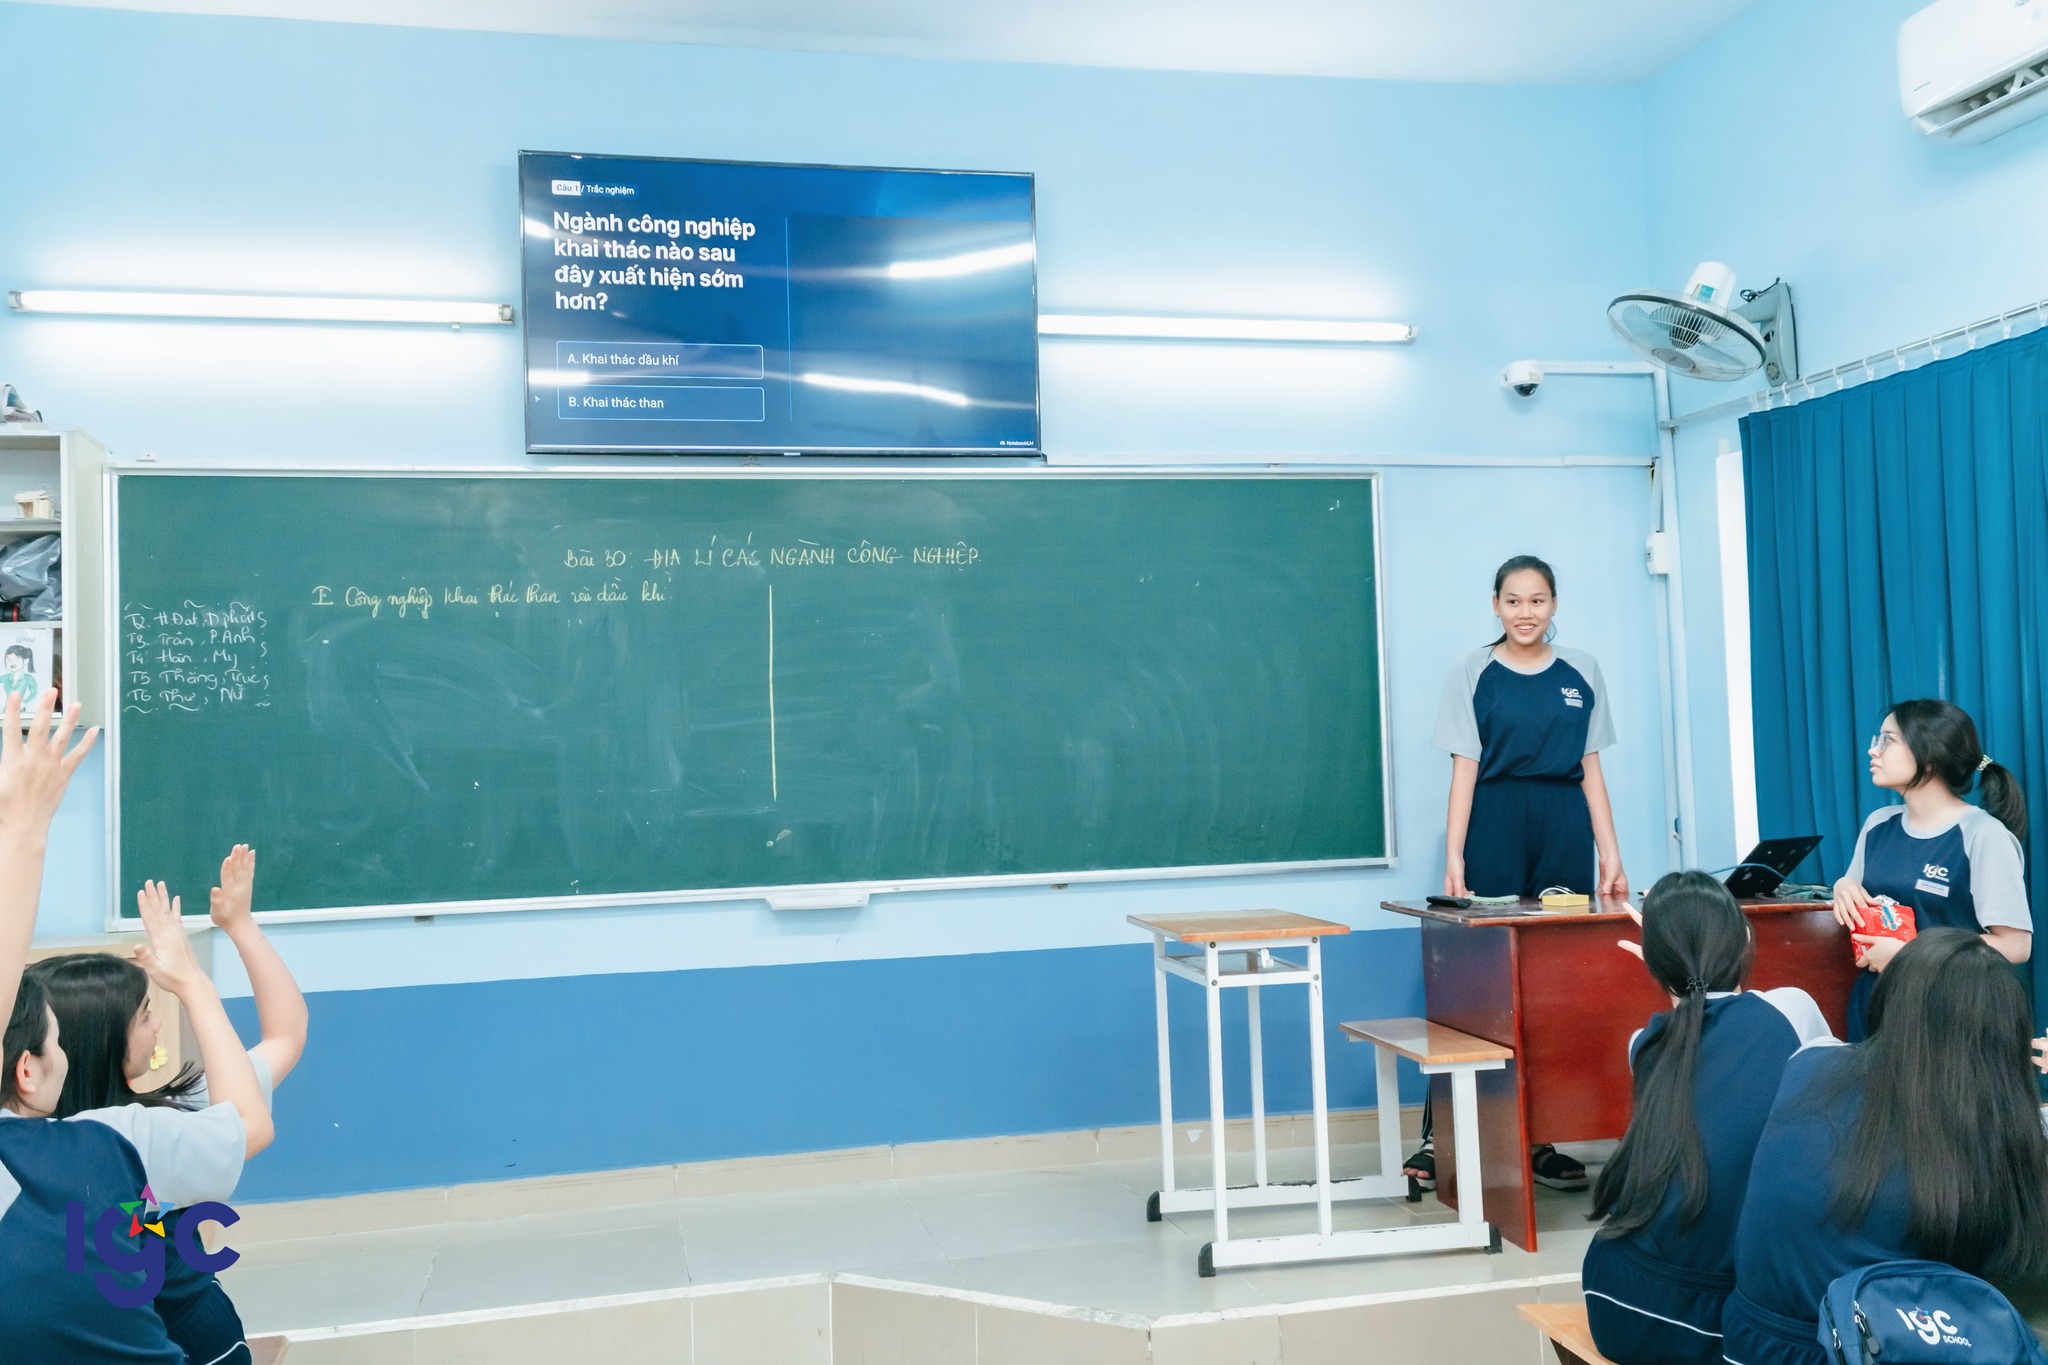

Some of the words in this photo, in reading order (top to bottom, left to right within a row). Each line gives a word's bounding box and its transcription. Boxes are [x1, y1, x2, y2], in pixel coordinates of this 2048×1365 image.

[556, 183, 573, 192] Câu
[586, 184, 604, 194] Trắc
[605, 185, 635, 196] nghiệm
[553, 211, 623, 234] Ngành
[627, 214, 680, 238] công
[685, 217, 756, 241] nghiệp
[554, 238, 599, 258] khai
[604, 240, 651, 259] thác
[655, 241, 694, 261] nào
[698, 247, 736, 262] sau
[554, 264, 594, 287] đây
[599, 263, 646, 286] xuất
[650, 267, 695, 290] hiện
[699, 268, 744, 289] sớm
[555, 291, 608, 311] hơn?
[567, 353, 580, 365] A.
[582, 353, 608, 365] Khai
[610, 353, 636, 365] thác
[638, 352, 660, 366] dầu
[662, 354, 679, 366] khí
[568, 396, 580, 407] B.
[583, 396, 608, 408] Khai
[610, 397, 636, 408] thác
[638, 397, 664, 409] than
[564, 549, 595, 568] Bài
[695, 535, 717, 566] LÍ
[722, 531, 761, 567] CÁC
[769, 538, 835, 566] NGÀNH
[847, 539, 903, 564] CÔNG
[345, 586, 382, 618] Công
[387, 586, 433, 619] nghiệp
[487, 580, 519, 604] thác
[526, 583, 560, 604] than
[571, 585, 593, 603] và
[596, 577, 628, 602] dầu
[130, 670, 151, 686] T5
[126, 688, 152, 702] T6
[1942, 1334, 1972, 1348] SCHOOL
